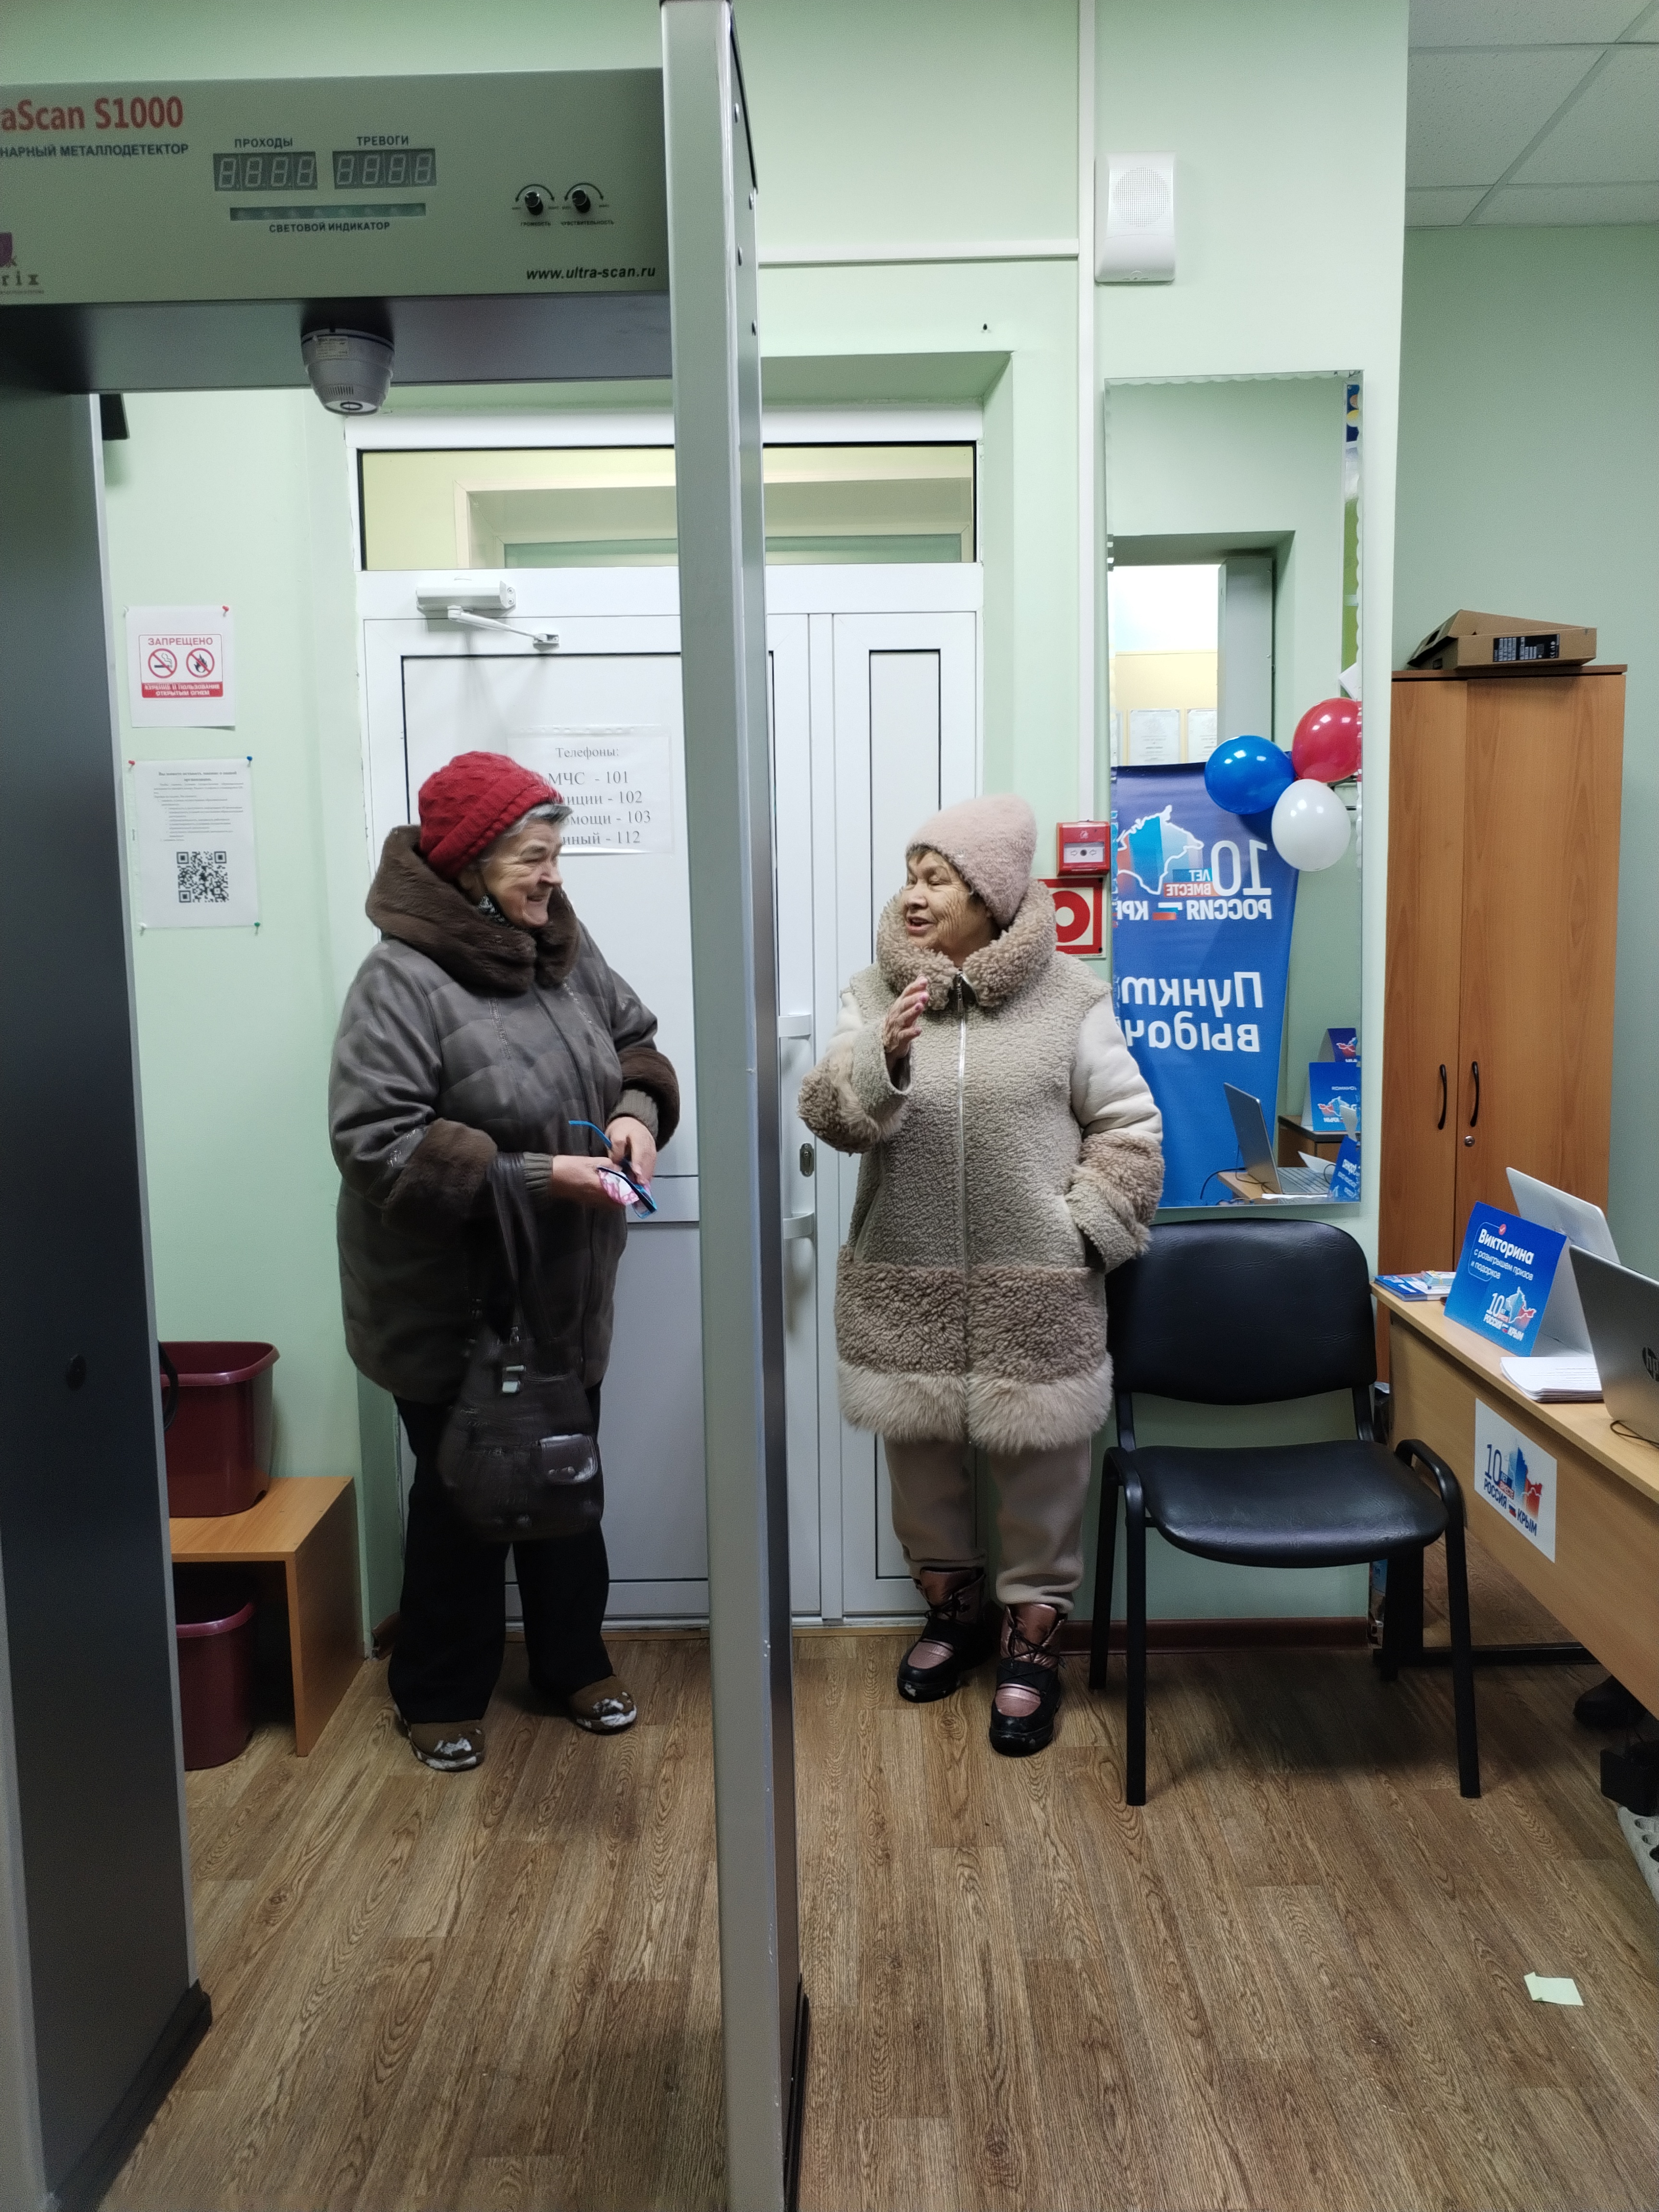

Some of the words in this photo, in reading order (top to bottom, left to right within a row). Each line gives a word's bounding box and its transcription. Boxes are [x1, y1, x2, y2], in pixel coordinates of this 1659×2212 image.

[95, 96, 183, 129] S1000
[234, 137, 293, 149] ПРОХОДЫ
[357, 135, 409, 146] ТРЕВОГИ
[60, 144, 189, 156] МЕТАЛЛОДЕТЕКТОР
[269, 222, 326, 233] СВЕТОВОЙ
[328, 221, 390, 232] ИНДИКАТОР
[527, 265, 656, 280] www.ultra-scan.ru
[148, 637, 213, 647] ЗАПРЕЩЕНО
[555, 746, 619, 760] Телефоны:
[549, 772, 585, 785] МЧС
[607, 771, 628, 784] 101
[563, 795, 603, 806] иции
[620, 791, 642, 804] 102
[628, 810, 650, 824] 103
[617, 830, 640, 844] 112
[1478, 1228, 1535, 1265] Викторина
[1474, 1262, 1501, 1279] подарков
[1477, 1250, 1514, 1271] розыгрышем
[1513, 1266, 1534, 1281] призов
[1486, 1292, 1505, 1317] 10
[1485, 1444, 1502, 1485] 10
[1484, 1478, 1507, 1509] РОССИЯ
[1517, 1508, 1538, 1537] КРЫМ
